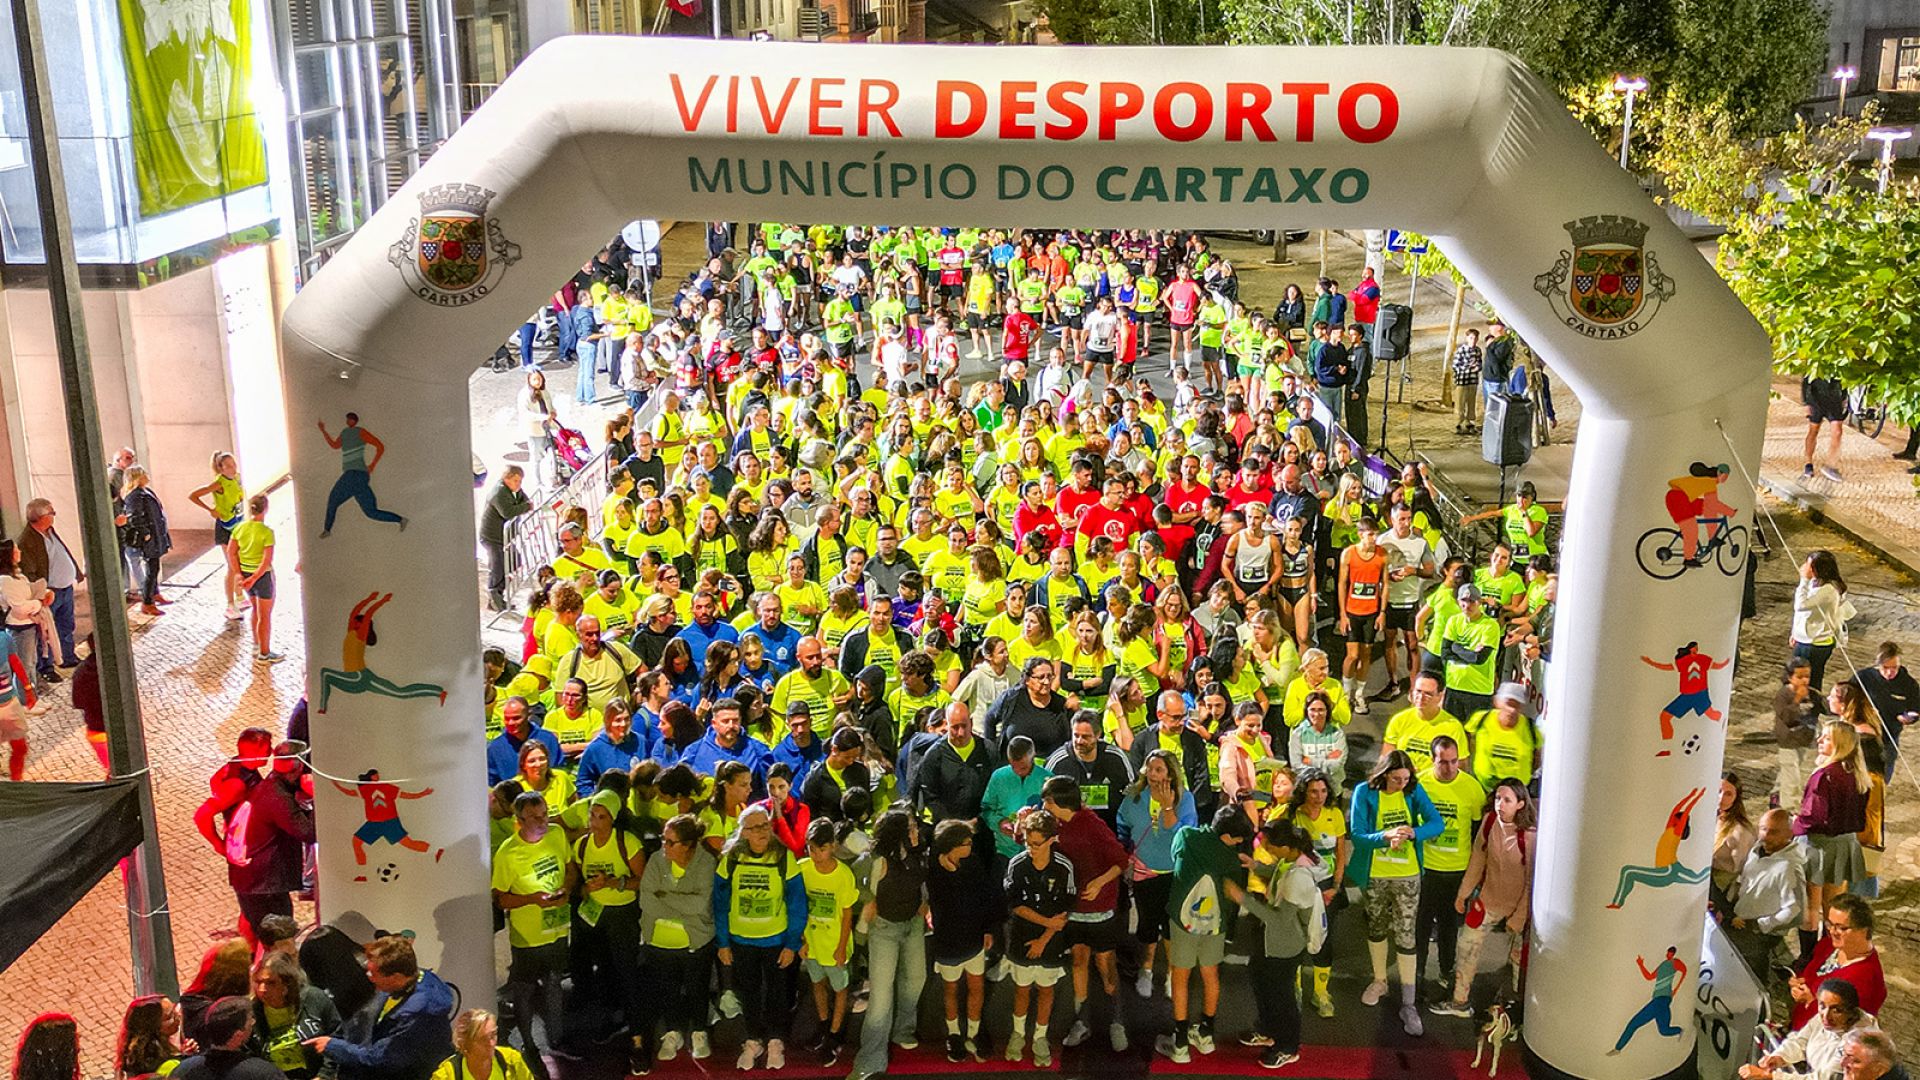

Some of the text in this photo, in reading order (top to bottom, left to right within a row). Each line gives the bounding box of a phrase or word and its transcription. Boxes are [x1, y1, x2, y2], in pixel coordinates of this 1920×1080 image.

[670, 74, 1400, 143] VIVER DESPORTO
[687, 151, 1370, 204] MUNICÍPIO DO CARTAXO
[418, 286, 488, 305] CARTAXO
[1566, 317, 1639, 338] CARTAXO
